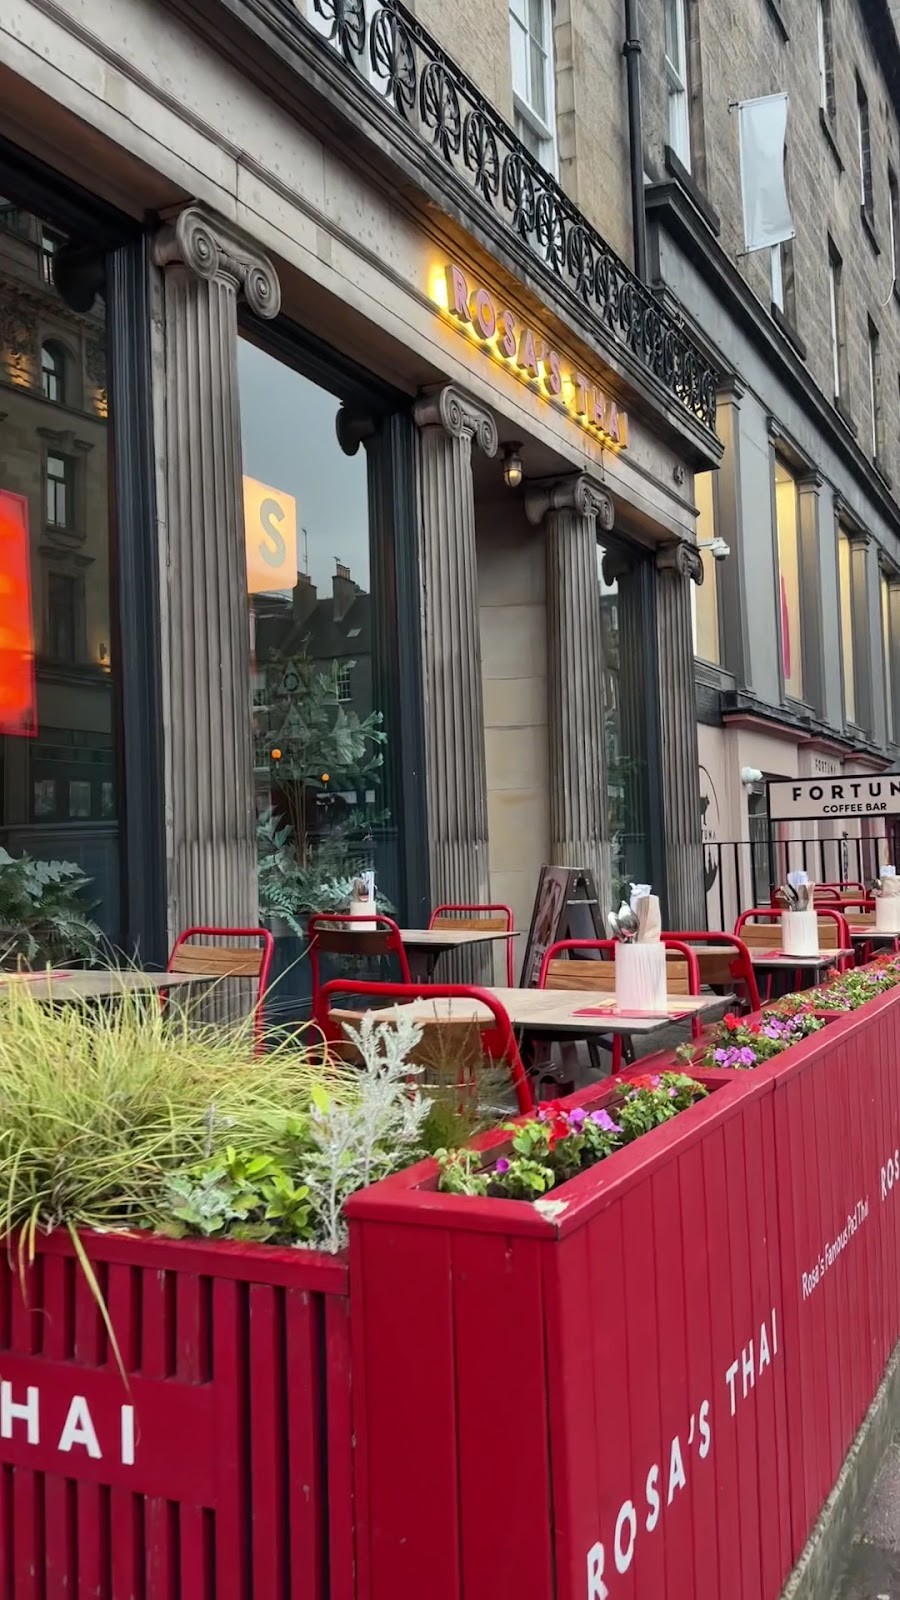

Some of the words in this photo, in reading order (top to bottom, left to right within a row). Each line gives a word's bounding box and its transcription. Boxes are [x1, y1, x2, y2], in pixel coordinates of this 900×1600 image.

[445, 263, 562, 395] ROSA'S
[571, 371, 628, 450] THAI
[258, 498, 286, 568] S
[823, 803, 863, 813] COFFEE
[866, 802, 887, 812] BAR
[802, 1254, 825, 1300] Rosa's
[824, 1226, 849, 1271] Famous
[847, 1206, 858, 1238] Pad
[0, 1380, 134, 1466] HAI
[586, 1399, 711, 1600] ROSA'S
[725, 1307, 778, 1417] THAI
